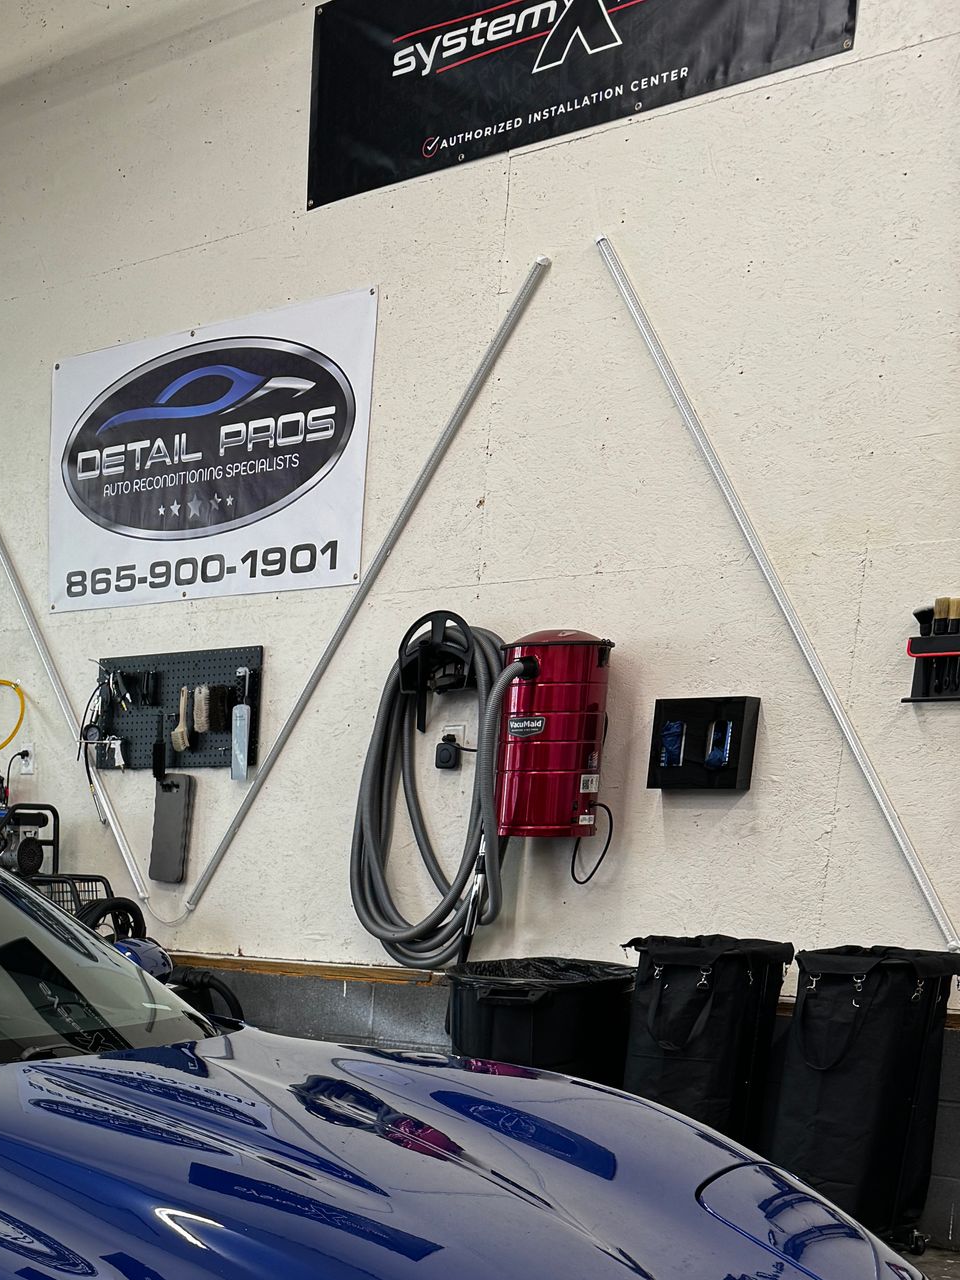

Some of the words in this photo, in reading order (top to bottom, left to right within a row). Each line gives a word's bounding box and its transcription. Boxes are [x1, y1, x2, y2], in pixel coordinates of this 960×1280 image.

[392, 0, 557, 77] system
[440, 116, 522, 149] AUTHORIZED
[528, 84, 624, 124] INSTALLATION
[630, 66, 689, 92] CENTER
[76, 432, 202, 480] DETAIL
[219, 405, 336, 456] PROS
[103, 479, 131, 497] AUTO
[133, 463, 223, 493] RECONDITIONING
[225, 452, 300, 478] SPECIALISTS
[66, 540, 338, 597] 865-900-1901
[510, 720, 542, 729] VacuMaid
